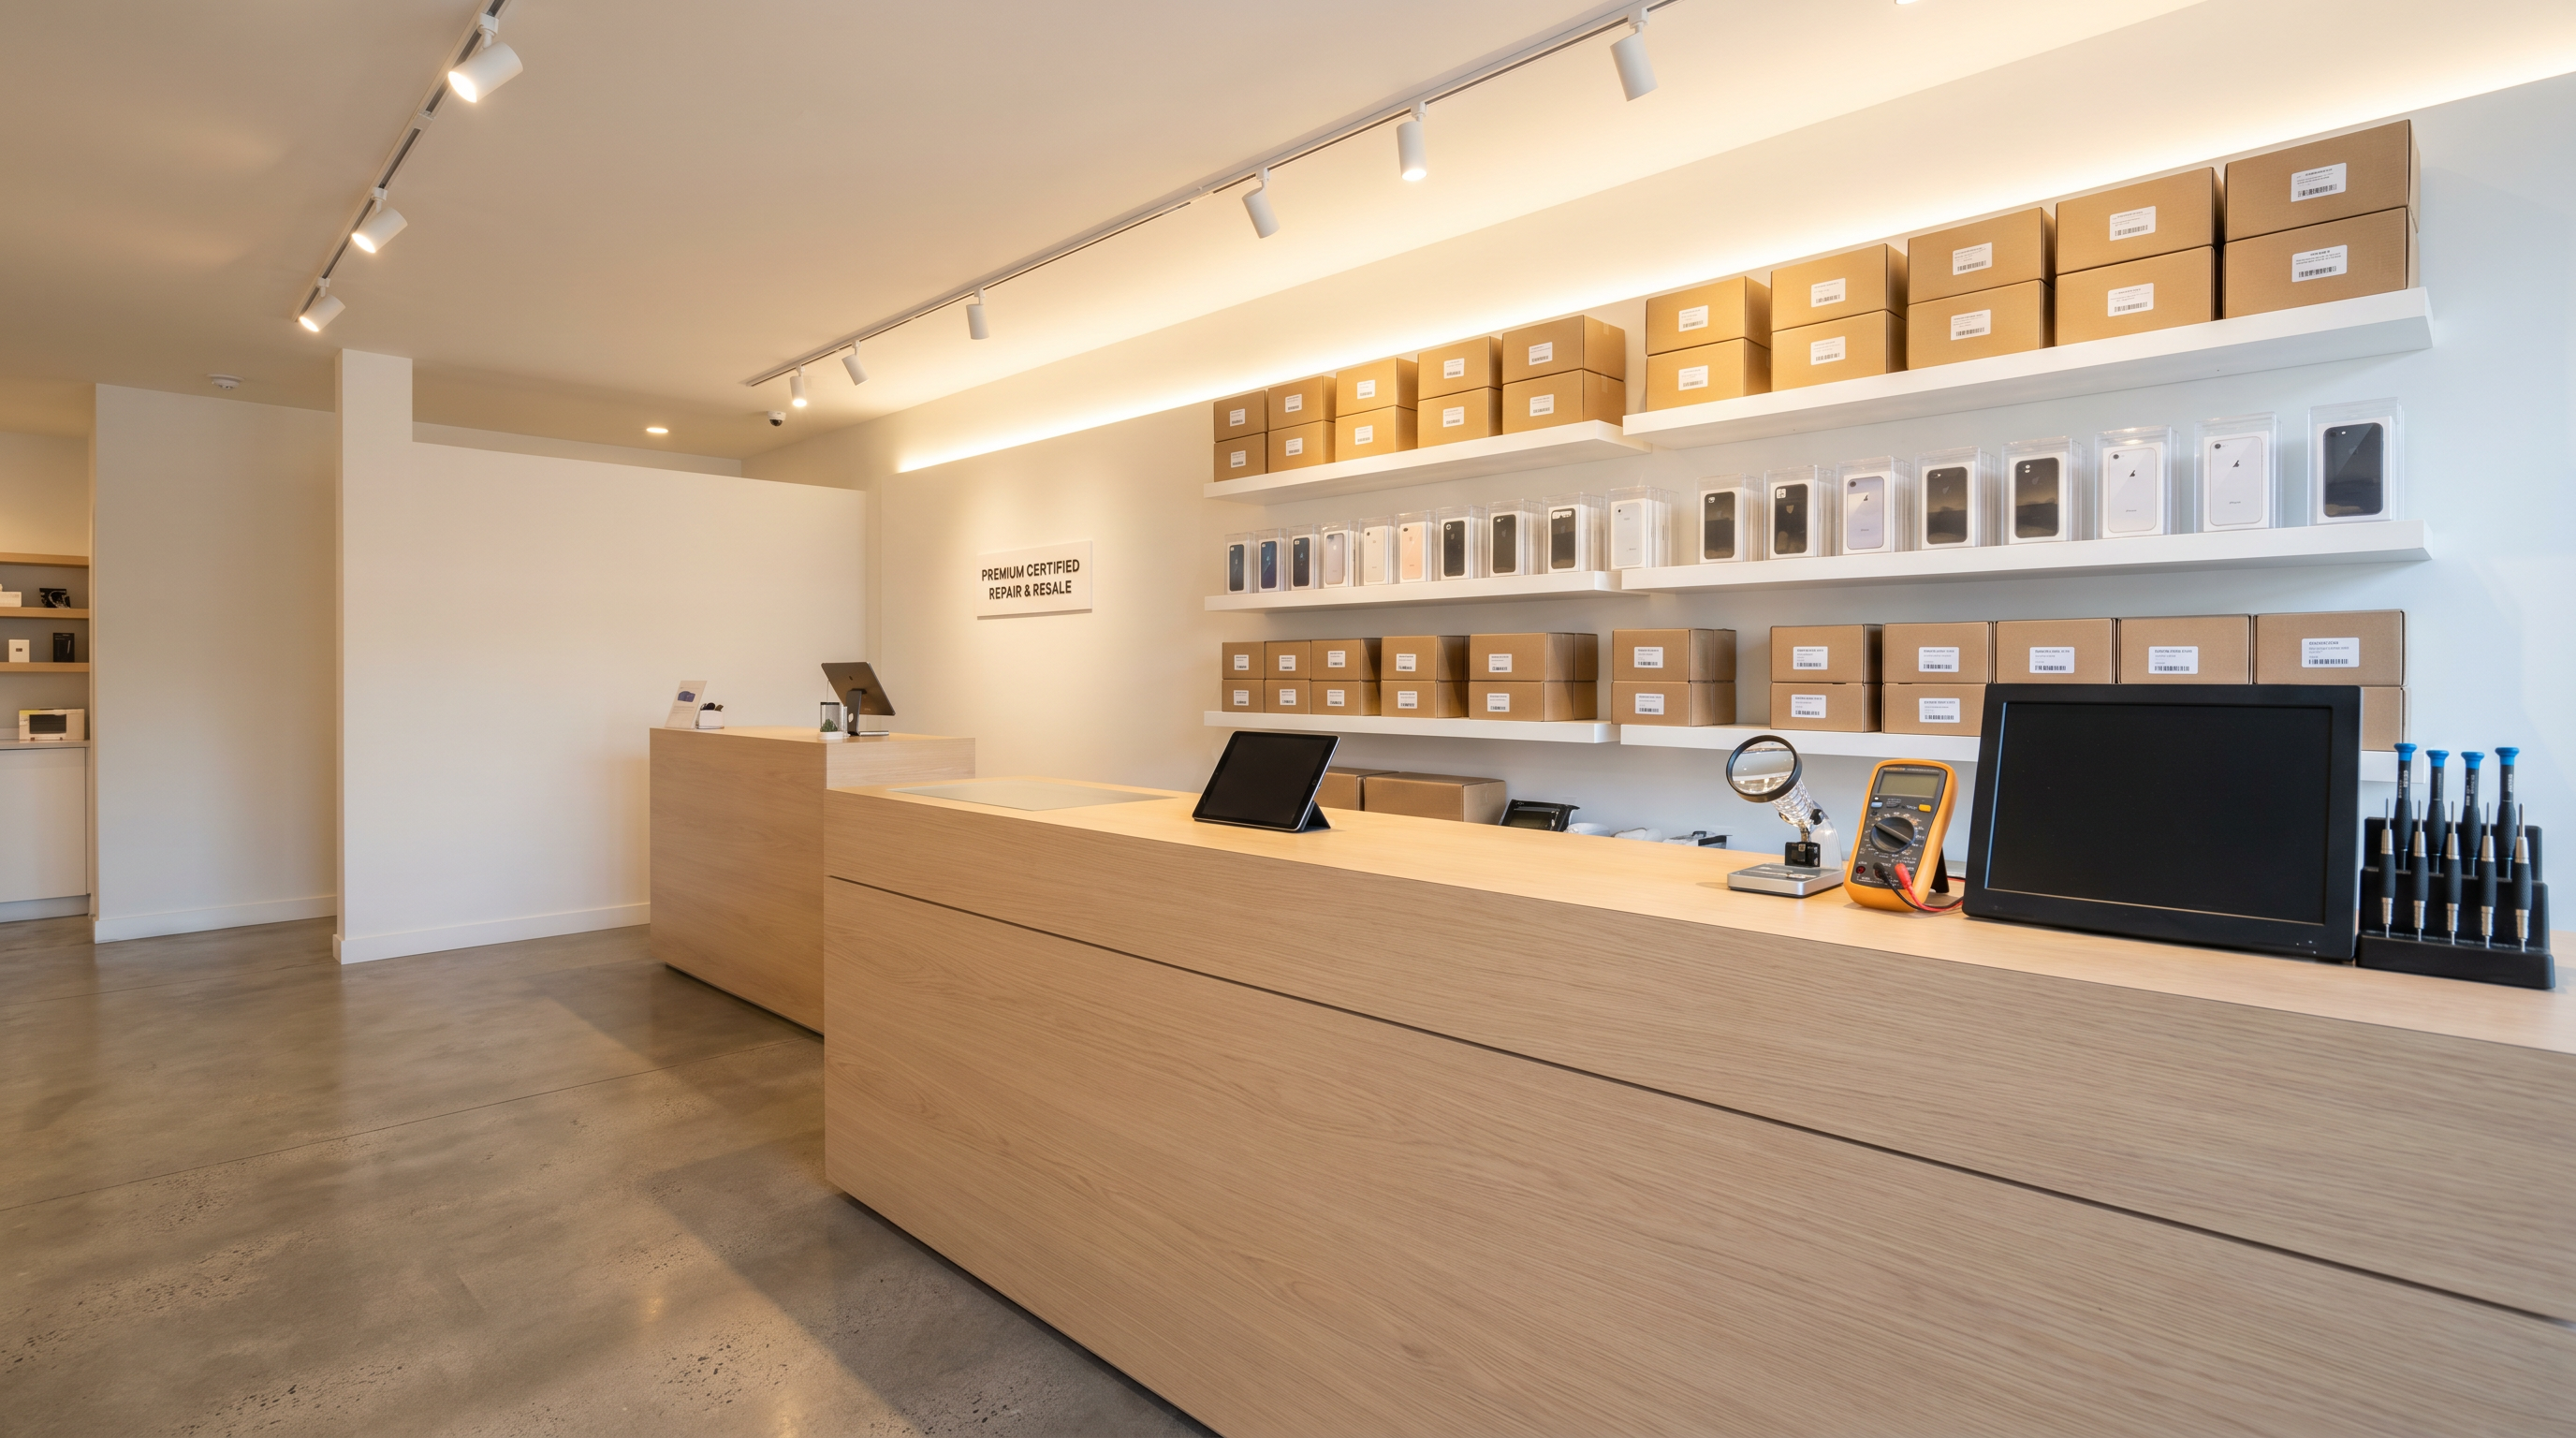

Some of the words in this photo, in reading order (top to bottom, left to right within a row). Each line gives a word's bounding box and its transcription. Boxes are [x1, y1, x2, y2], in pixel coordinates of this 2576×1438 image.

[981, 565, 1024, 581] PREMIUM
[1026, 559, 1080, 577] CERTIFIED
[988, 585, 1022, 600] REPAIR
[1024, 584, 1031, 597] &
[1032, 580, 1072, 596] RESALE
